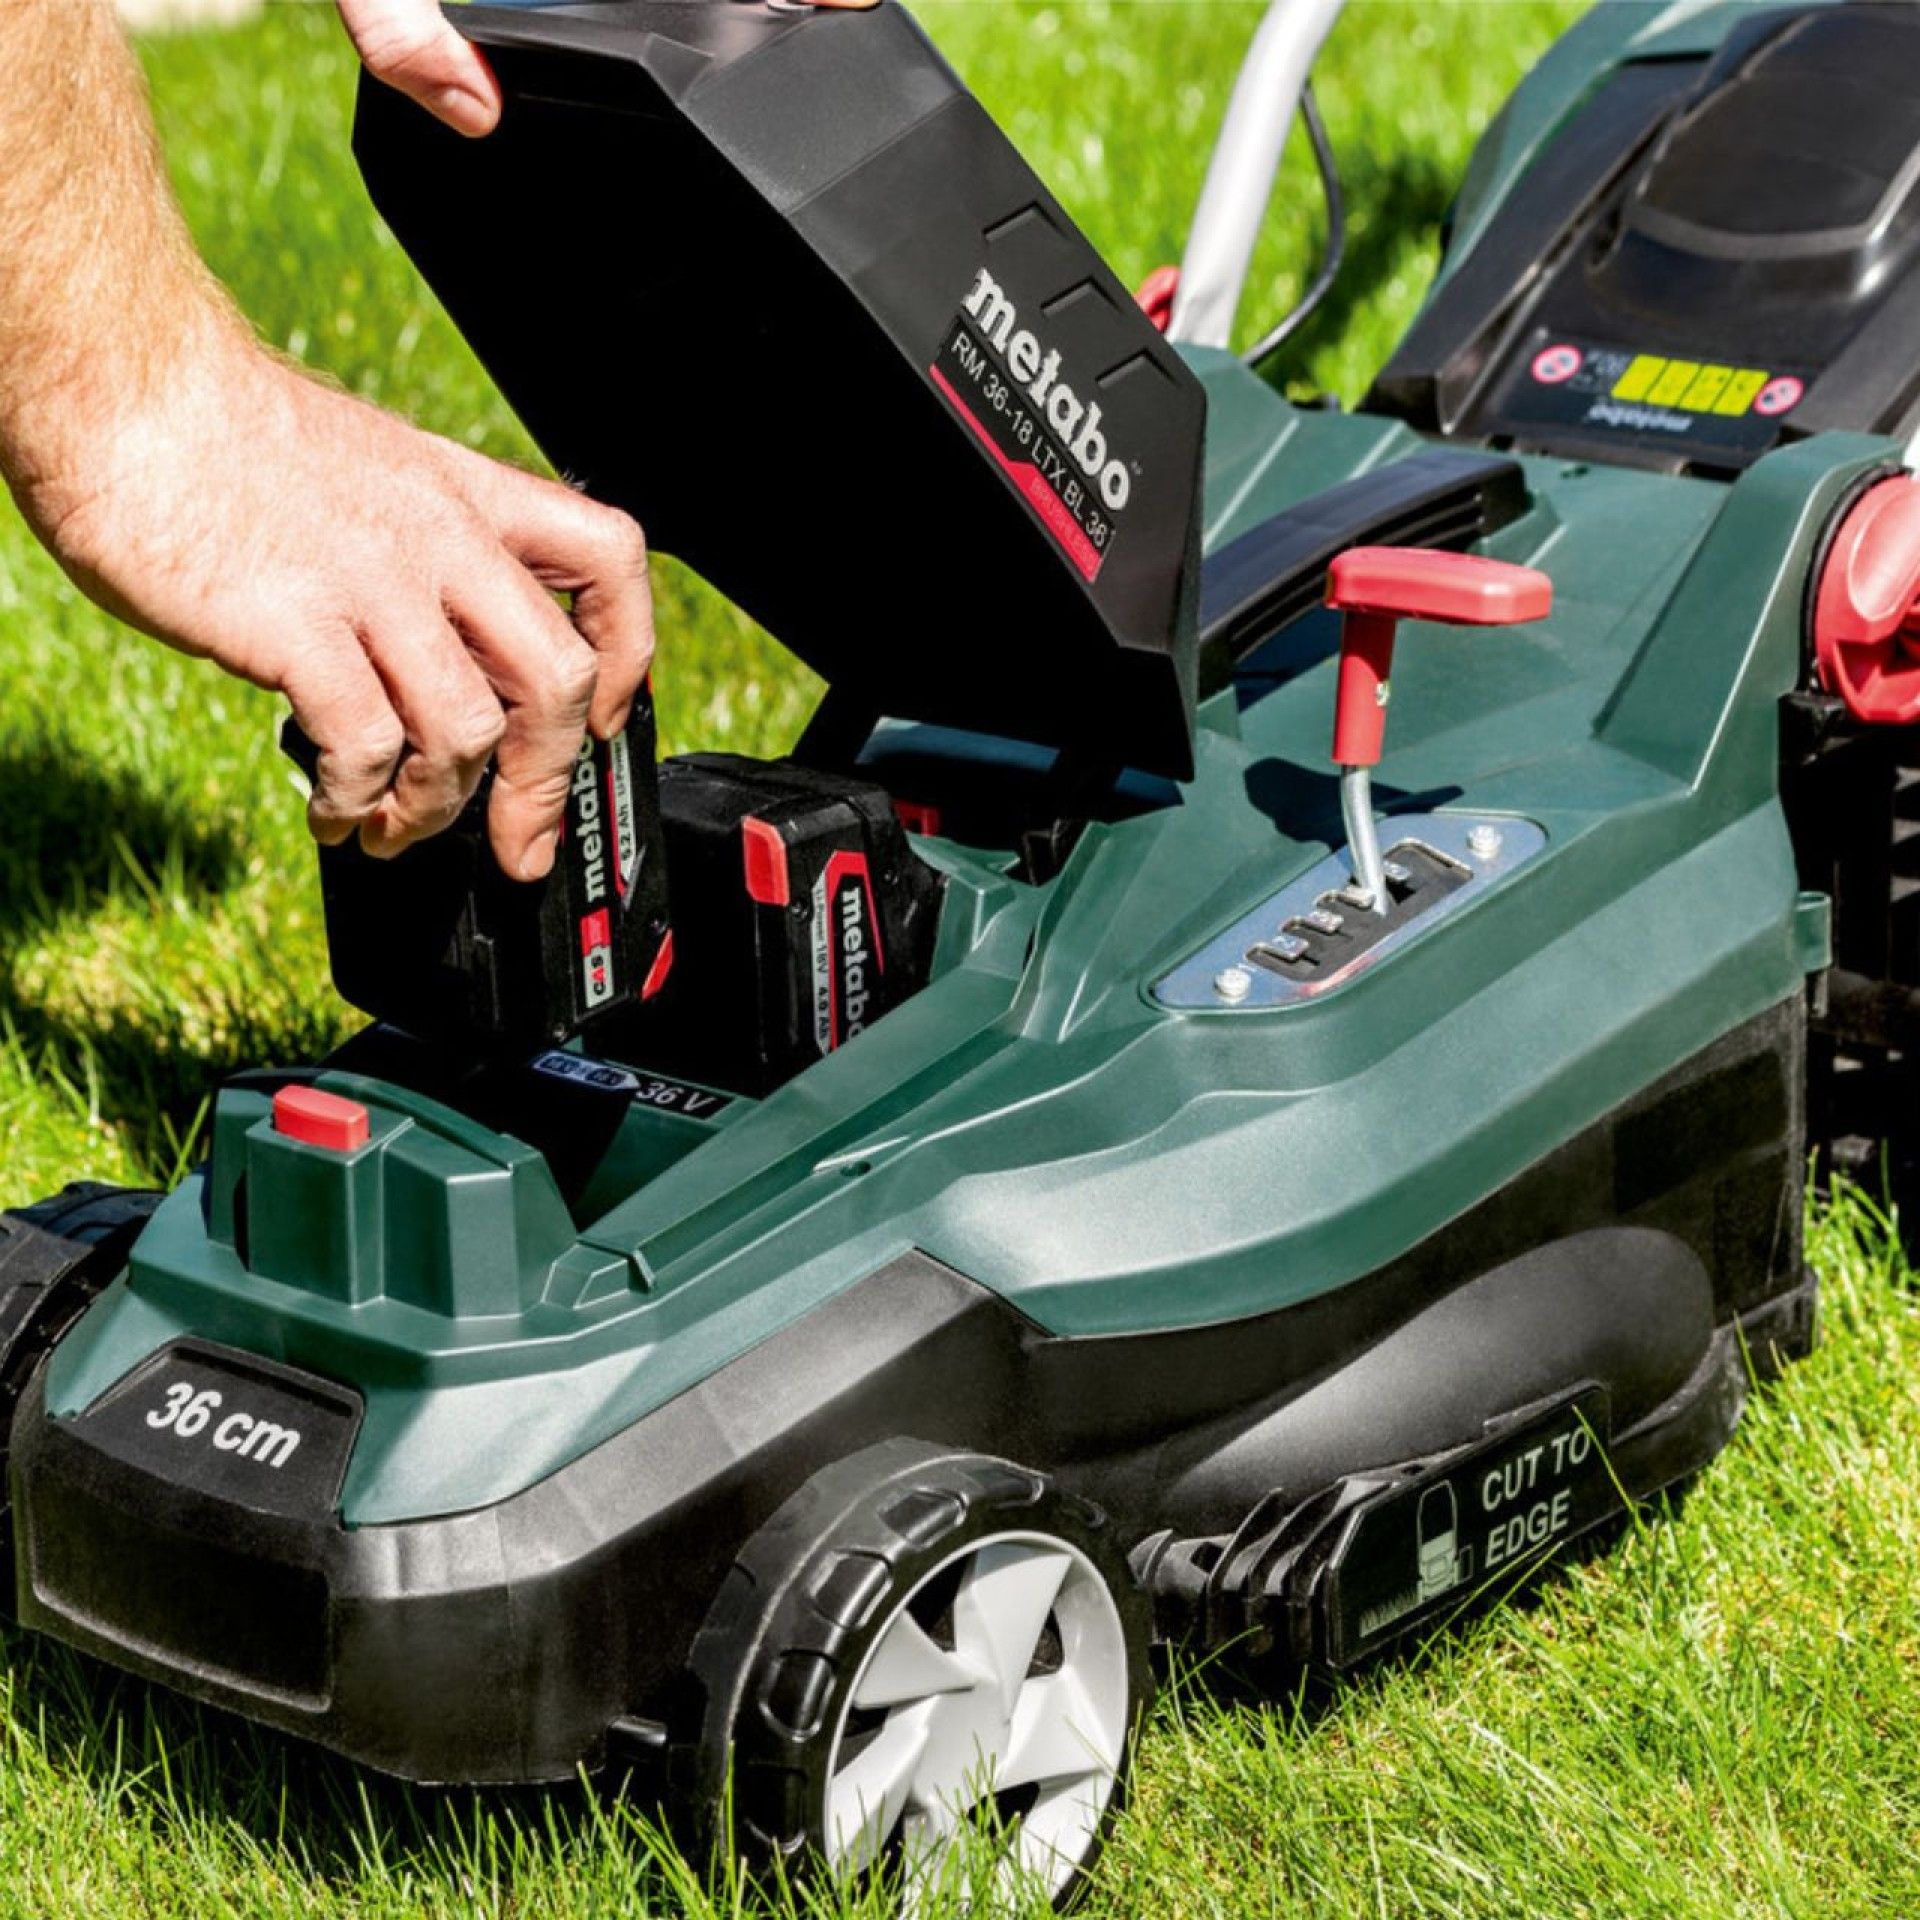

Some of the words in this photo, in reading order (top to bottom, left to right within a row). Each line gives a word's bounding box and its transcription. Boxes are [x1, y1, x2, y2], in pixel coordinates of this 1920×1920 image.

[960, 266, 1130, 511] metabo
[951, 330, 986, 382] RM
[982, 372, 1033, 447] 36-18
[1030, 434, 1066, 490] LTX
[1062, 479, 1084, 523] BL
[1084, 510, 1108, 548] 36
[574, 732, 604, 903] metabo
[591, 955, 607, 996] CAS
[636, 1081, 677, 1103] 36
[683, 1092, 718, 1113] V
[146, 1381, 223, 1438] 36
[212, 1412, 301, 1468] cm
[1482, 1446, 1543, 1512] CUT
[1550, 1425, 1591, 1475] TO
[1485, 1489, 1571, 1569] EDGE
